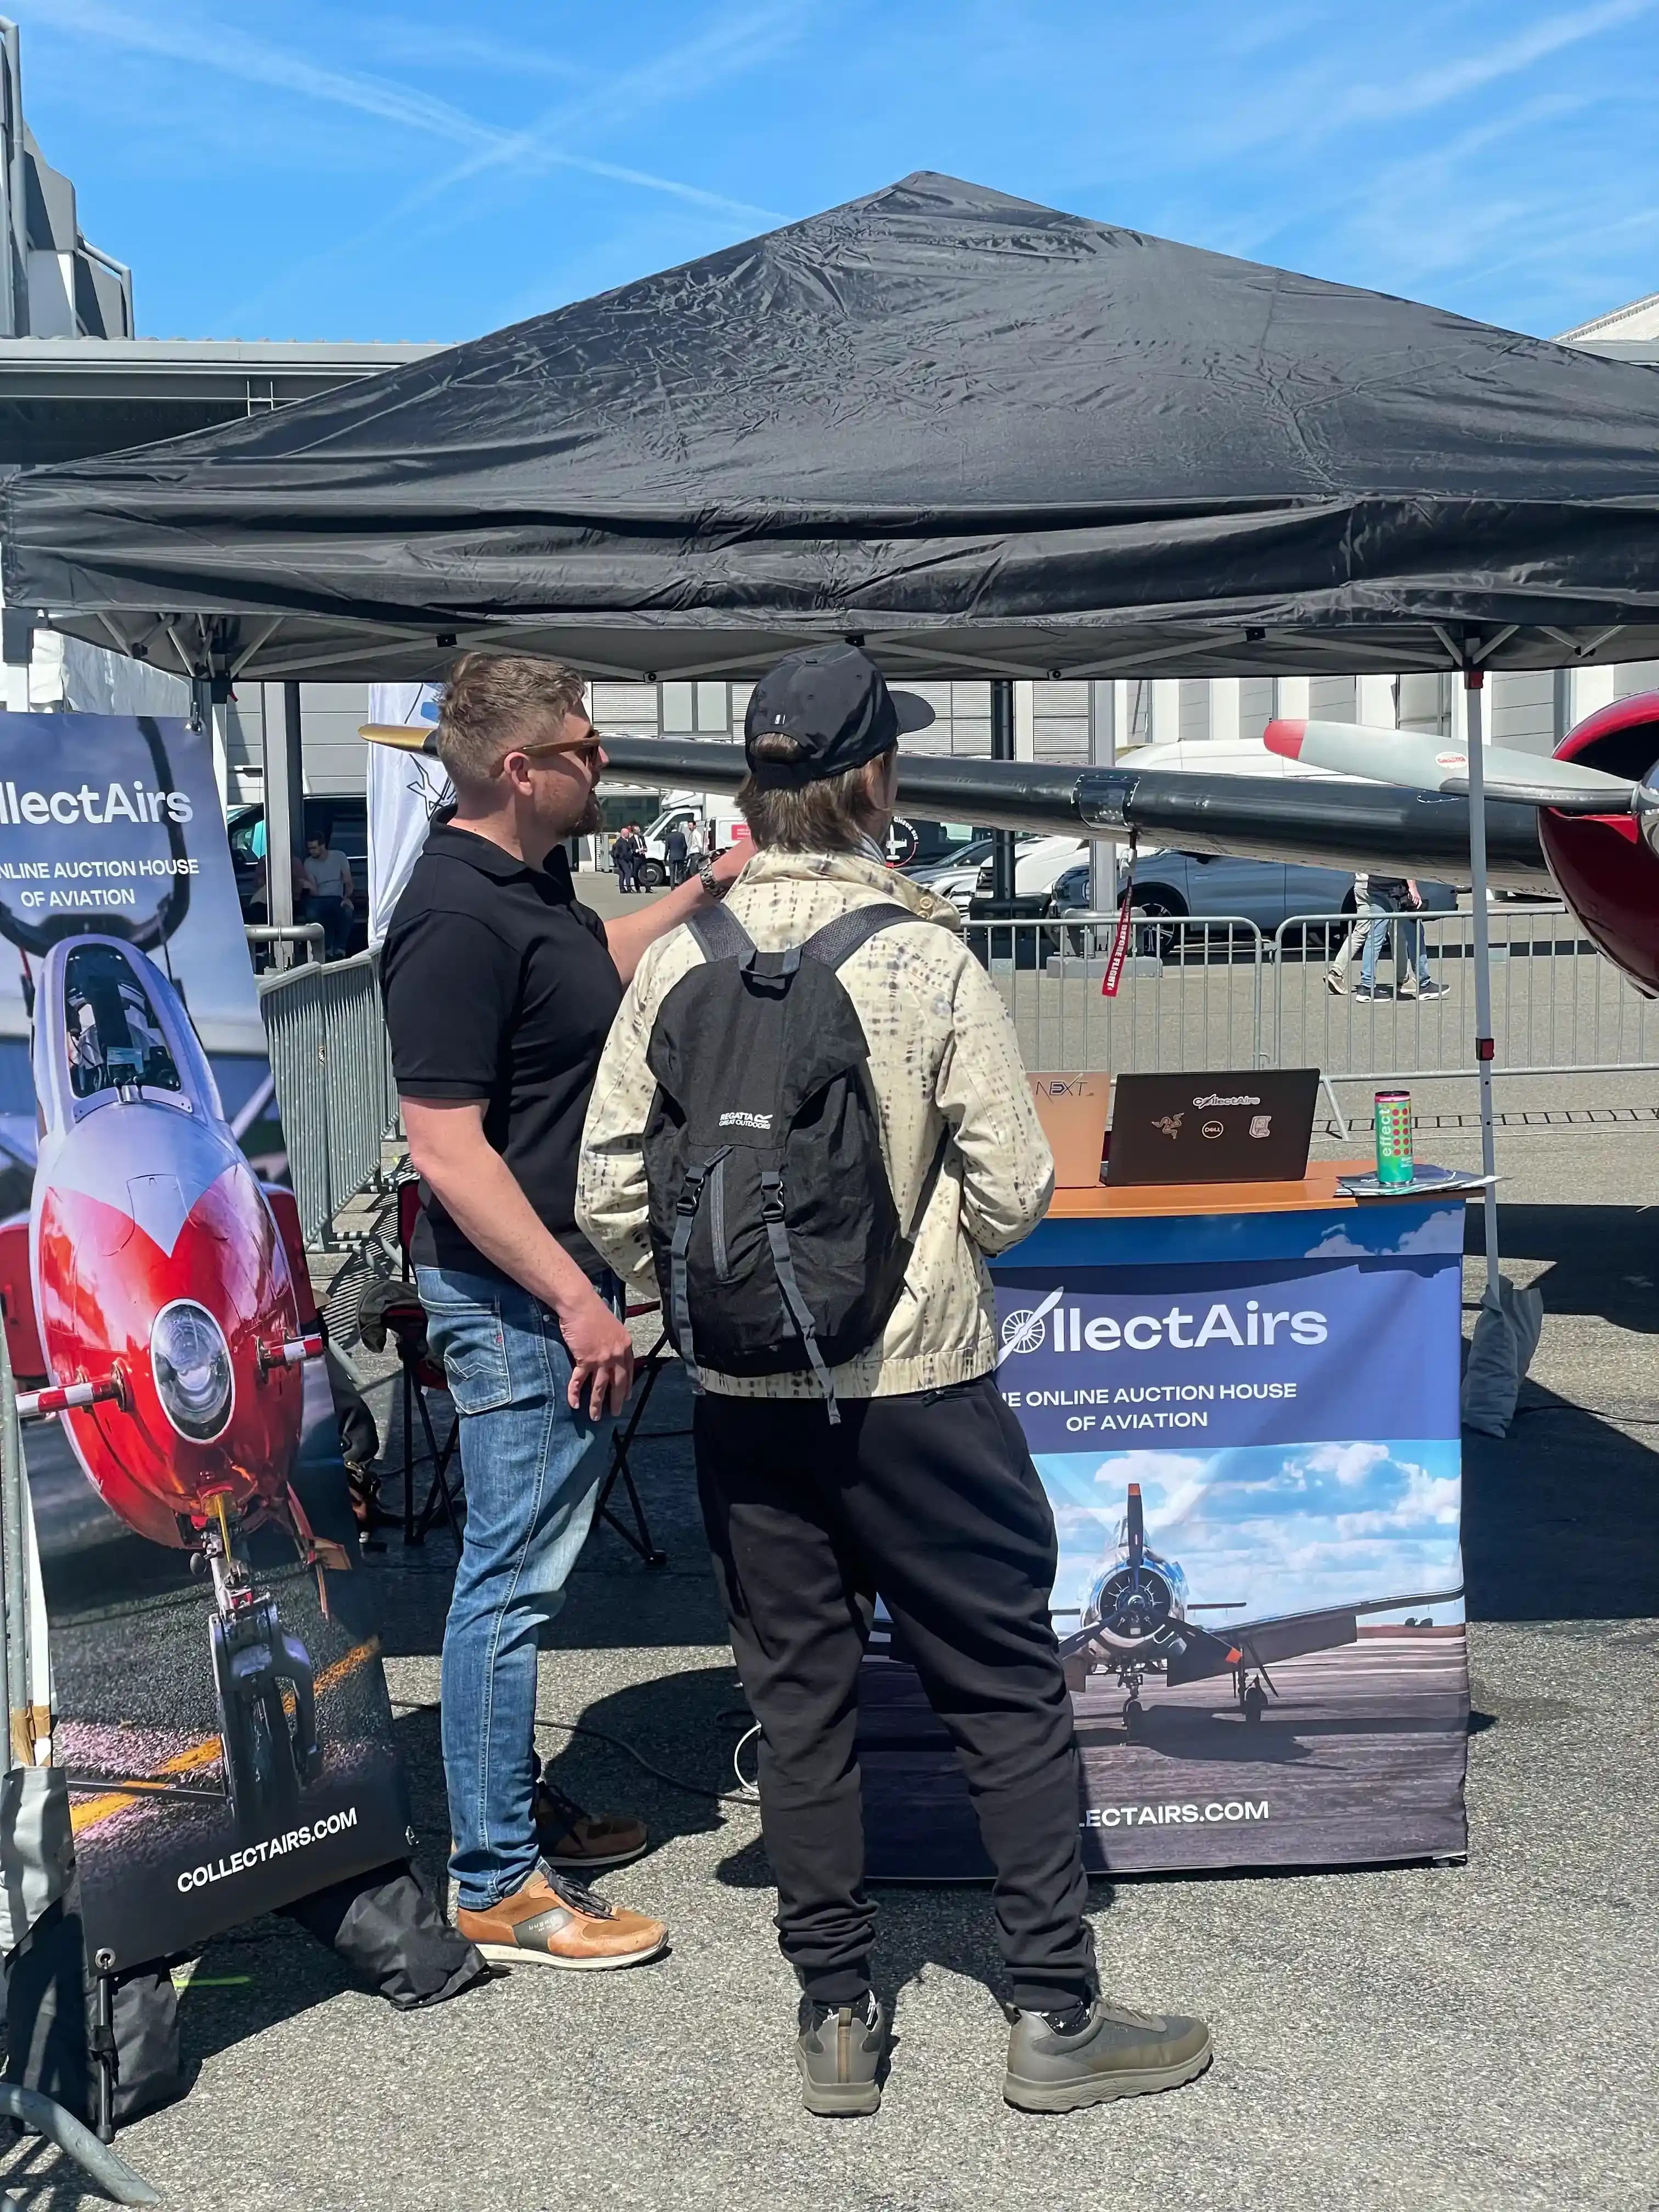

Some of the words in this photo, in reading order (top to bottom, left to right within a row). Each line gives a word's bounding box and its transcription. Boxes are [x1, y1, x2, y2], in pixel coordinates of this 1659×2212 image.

[54, 860, 136, 878] AUCTION
[139, 859, 200, 876] HOUSE
[21, 891, 45, 907] OF
[50, 888, 136, 906] AVIATION
[1115, 924, 1127, 957] BEFORE
[1107, 958, 1120, 990] FLIGHT
[720, 1112, 753, 1121] REGATTA
[736, 1119, 770, 1129] OUTDOORS
[1379, 1108, 1391, 1156] effect
[1026, 1389, 1109, 1407] ONLINE
[1114, 1385, 1214, 1403] AUCTION
[1220, 1383, 1297, 1399] HOUSE
[1066, 1415, 1096, 1431] OF
[1100, 1412, 1207, 1430] AVIATION
[177, 1807, 358, 1893] COLLECTAIRS.COM
